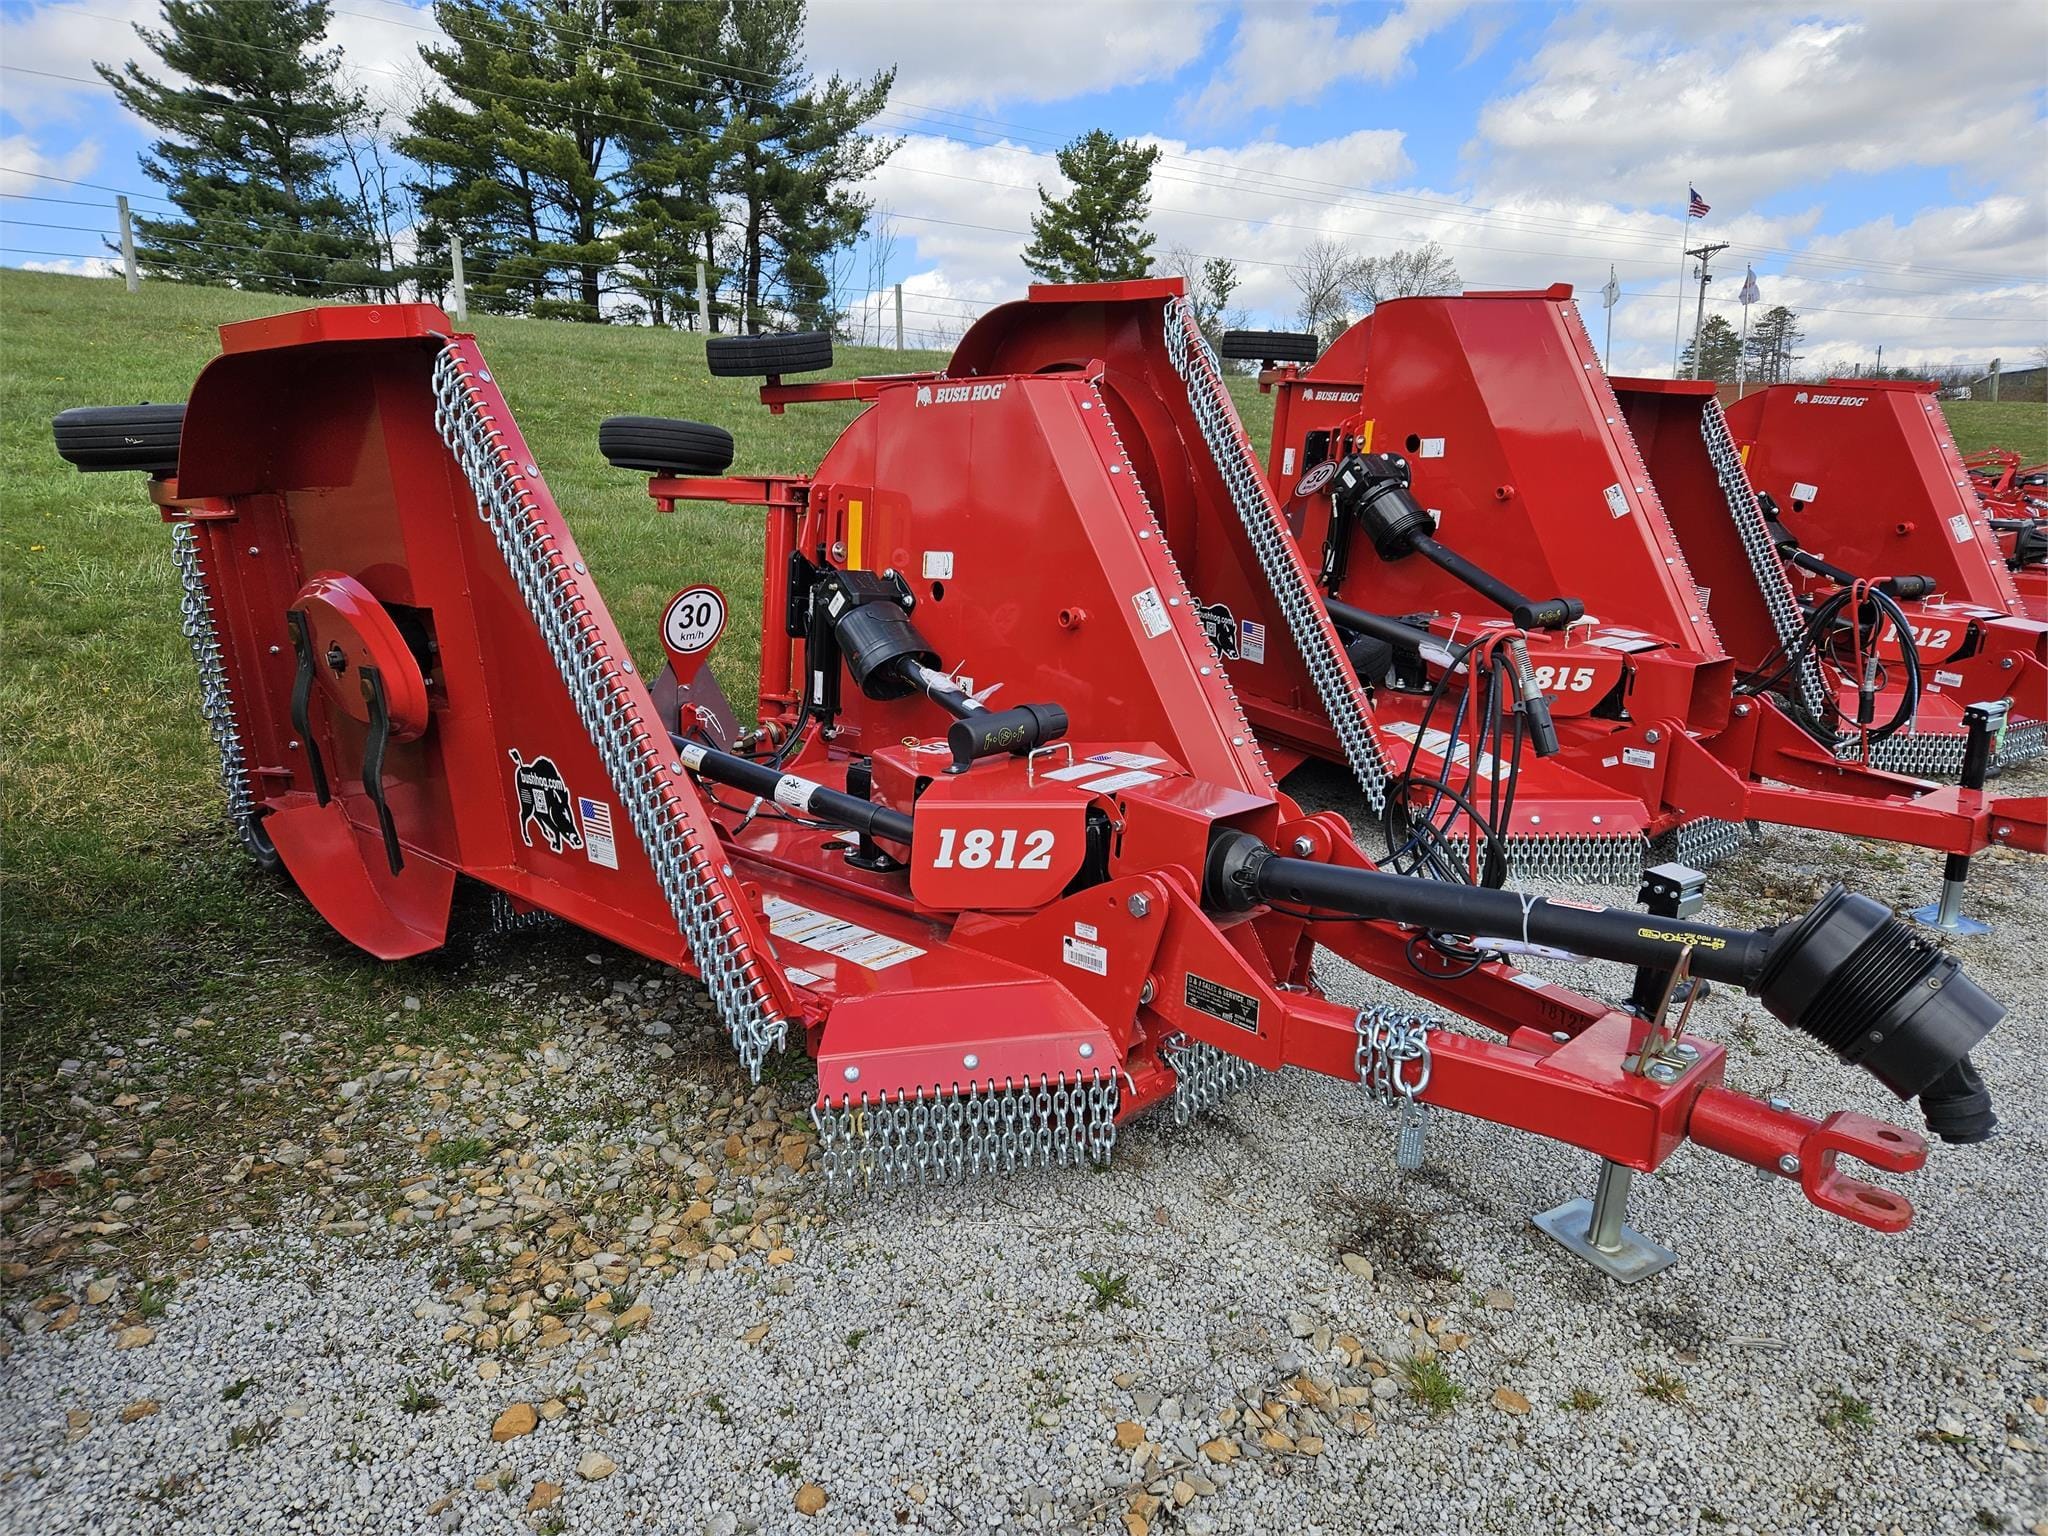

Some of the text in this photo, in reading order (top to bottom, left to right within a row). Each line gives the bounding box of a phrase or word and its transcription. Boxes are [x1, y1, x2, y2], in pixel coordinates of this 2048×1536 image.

[935, 383, 1003, 403] BUSH HOG
[1315, 391, 1360, 402] BUSH HOG
[1810, 394, 1866, 407] BUSH HOG
[1306, 469, 1330, 484] 30
[679, 602, 711, 629] 30
[680, 631, 704, 641] km/h
[1519, 666, 1595, 692] 815
[520, 769, 564, 791] bushhog.com
[933, 828, 1055, 870] 1812
[1202, 981, 1217, 993] SALES
